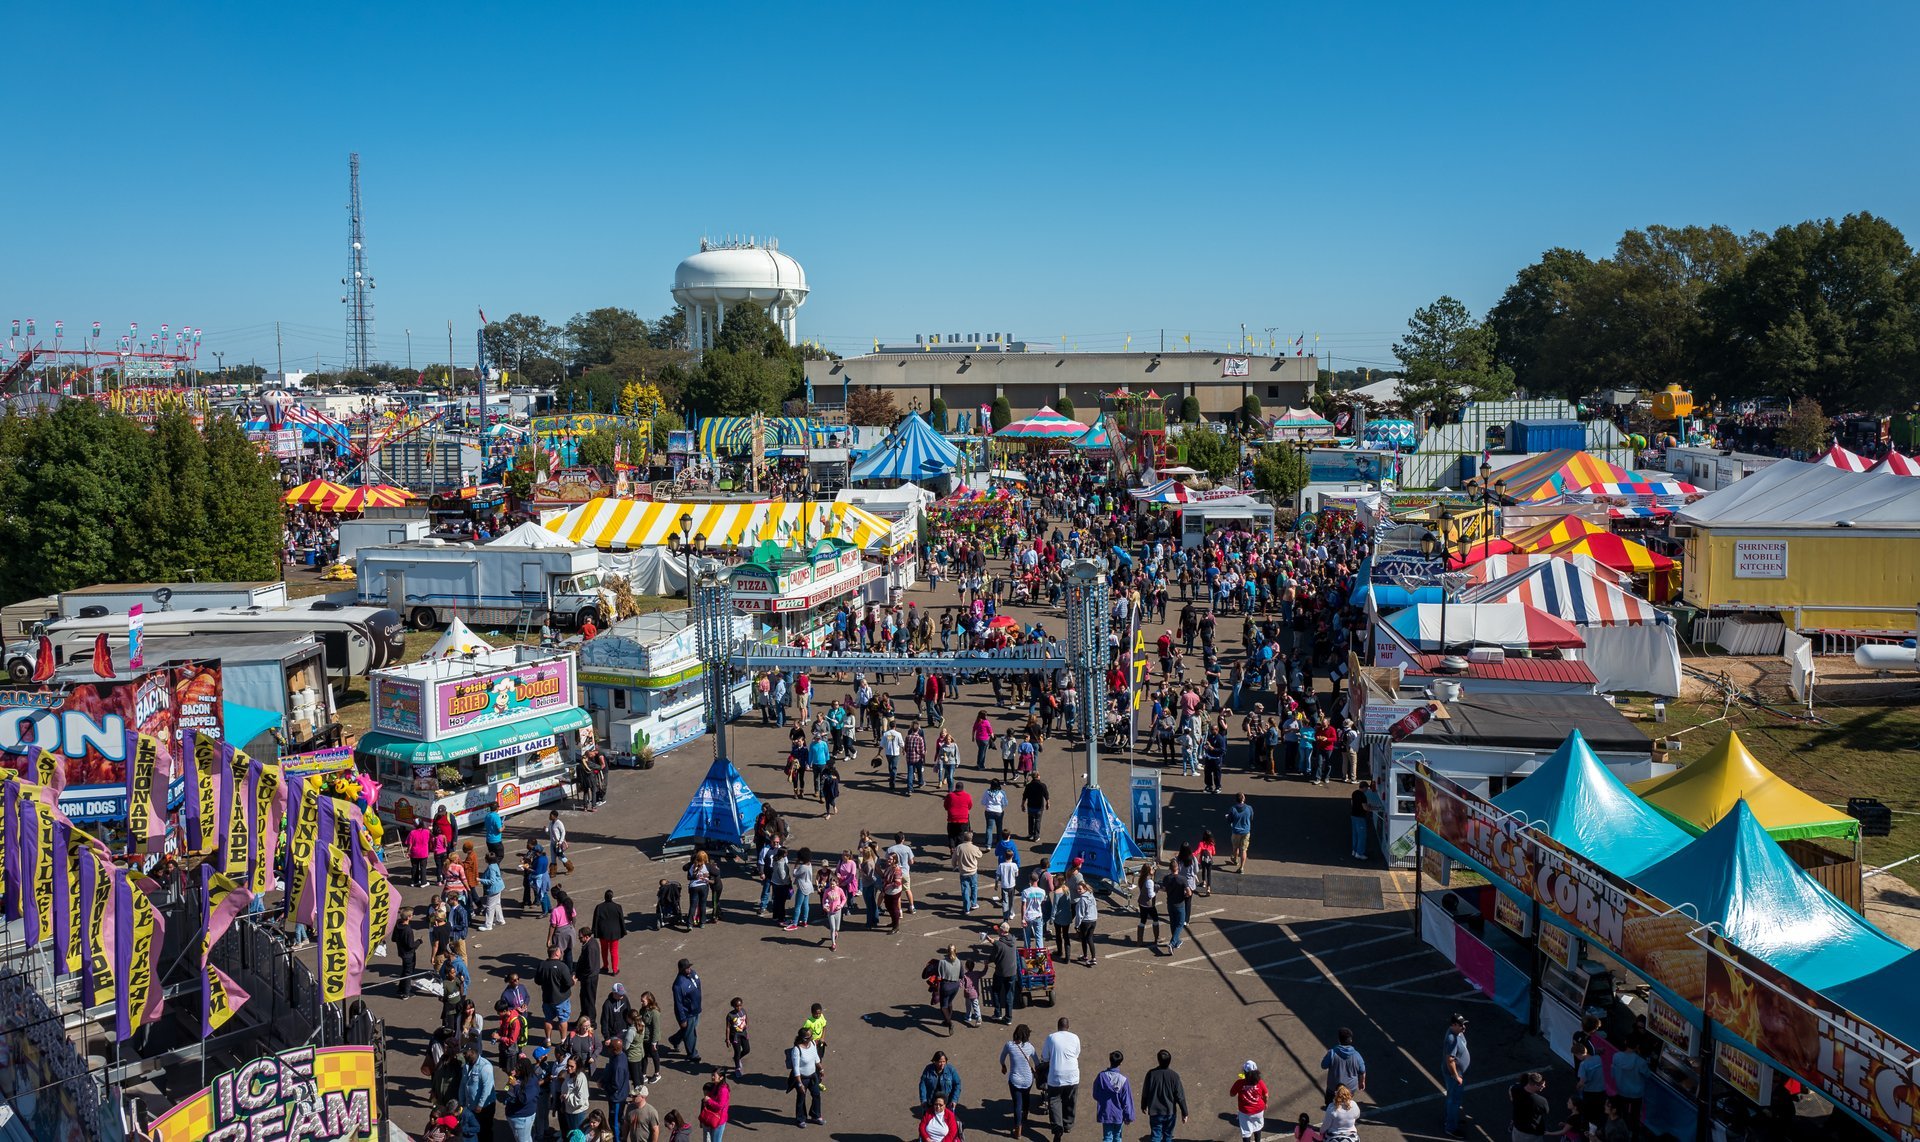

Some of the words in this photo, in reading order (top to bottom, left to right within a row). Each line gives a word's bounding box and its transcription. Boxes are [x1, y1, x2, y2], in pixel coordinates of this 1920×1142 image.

[816, 562, 835, 578] PIZZERIA
[737, 580, 768, 591] PIZZA
[1377, 643, 1396, 651] TATER
[1380, 652, 1393, 660] HUT
[449, 693, 489, 716] FRIED
[516, 677, 560, 701] DOUGH
[536, 696, 560, 708] Delicious
[136, 687, 170, 729] BACON
[182, 704, 210, 716] BACON
[179, 716, 217, 727] WRAPPED
[449, 717, 465, 727] HOT
[499, 737, 517, 745] FRIED
[519, 731, 540, 741] DOUGH
[369, 747, 403, 760] LEMONADE
[448, 745, 478, 759] LEMONADE
[483, 745, 523, 762] FUNNEL
[525, 737, 552, 753] CAKES
[130, 738, 157, 844] LEMONADE
[86, 801, 116, 816] DOGS
[1136, 790, 1156, 840] ATM
[256, 773, 278, 886] SUNDAES
[1466, 818, 1527, 877] LEGS
[1470, 847, 1493, 869] FRESH
[1505, 871, 1522, 888] HOT
[1537, 865, 1624, 950] CORN
[1654, 1000, 1686, 1031] TURKEY
[1721, 1044, 1759, 1079] ROASTED
[218, 1047, 316, 1123] ICE
[1823, 1078, 1872, 1120] FRESH
